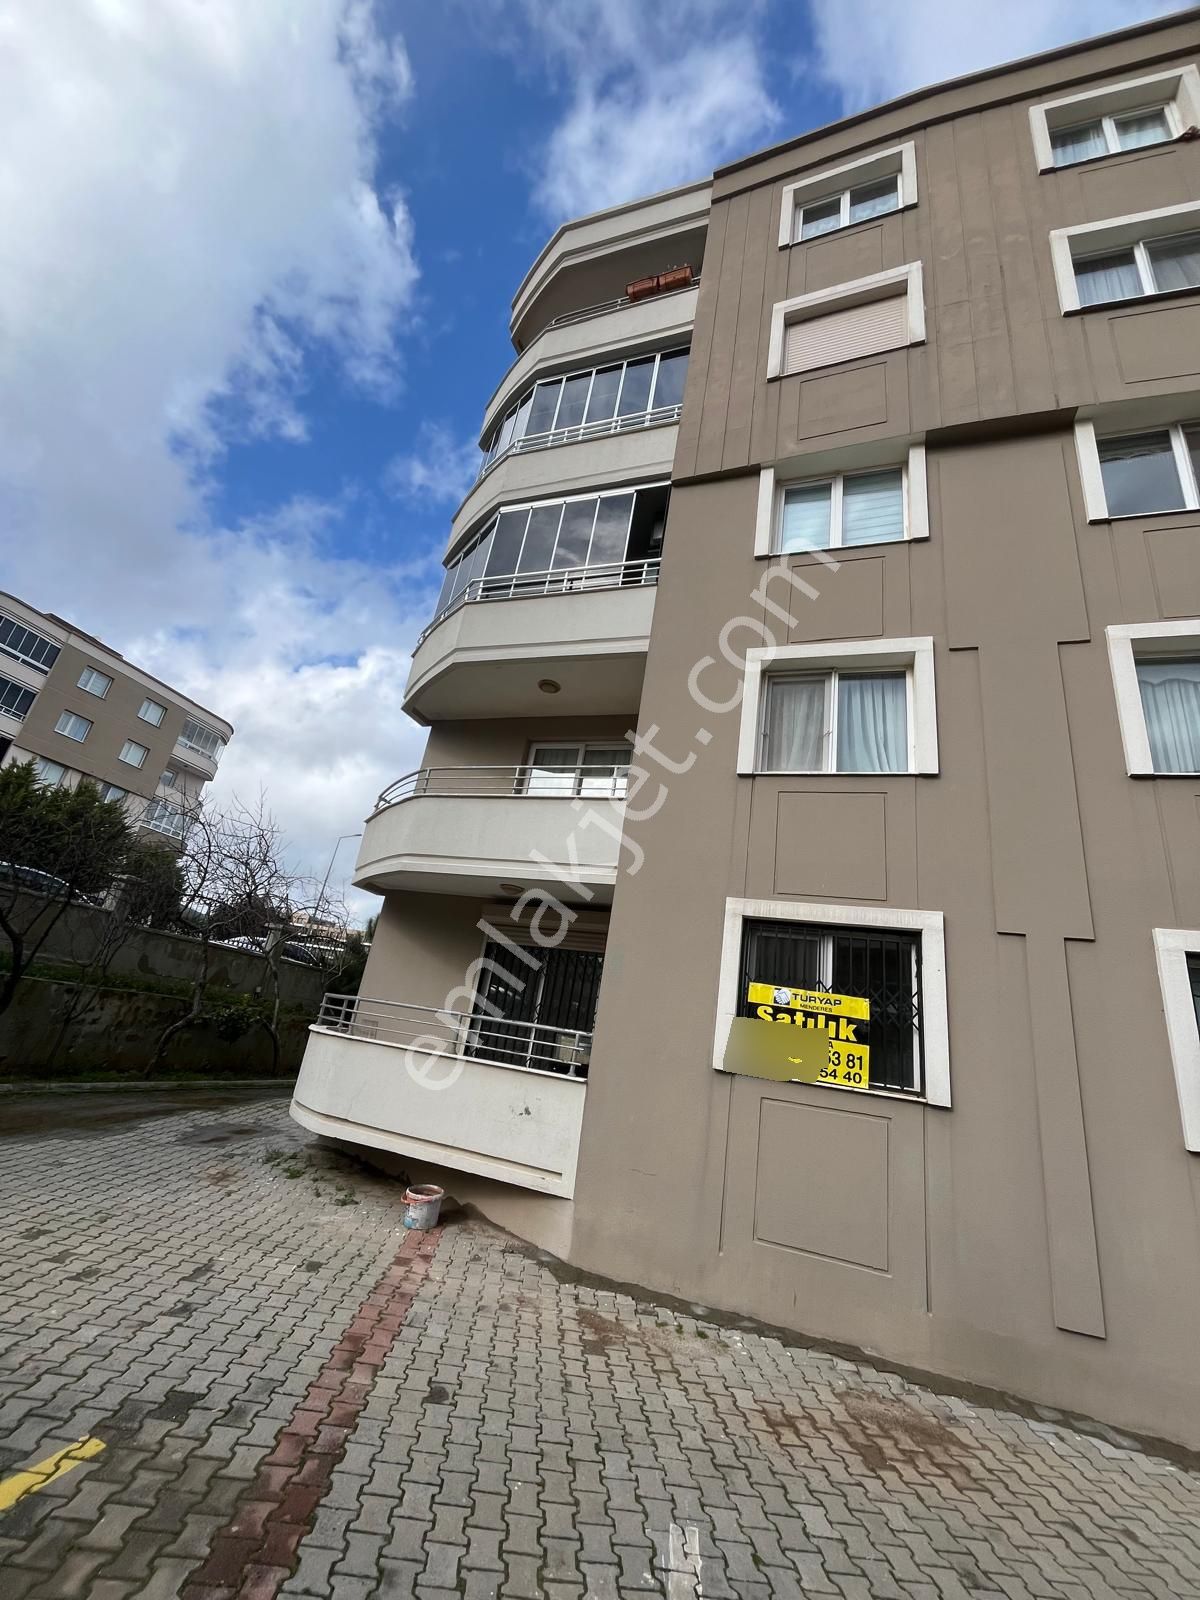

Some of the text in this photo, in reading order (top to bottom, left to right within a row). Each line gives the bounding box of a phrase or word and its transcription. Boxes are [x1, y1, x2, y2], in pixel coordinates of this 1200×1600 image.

[791, 993, 842, 1006] TURYAP
[799, 1003, 833, 1013] MENDERES
[846, 1053, 862, 1071] 81
[820, 1067, 862, 1084] 54 40
